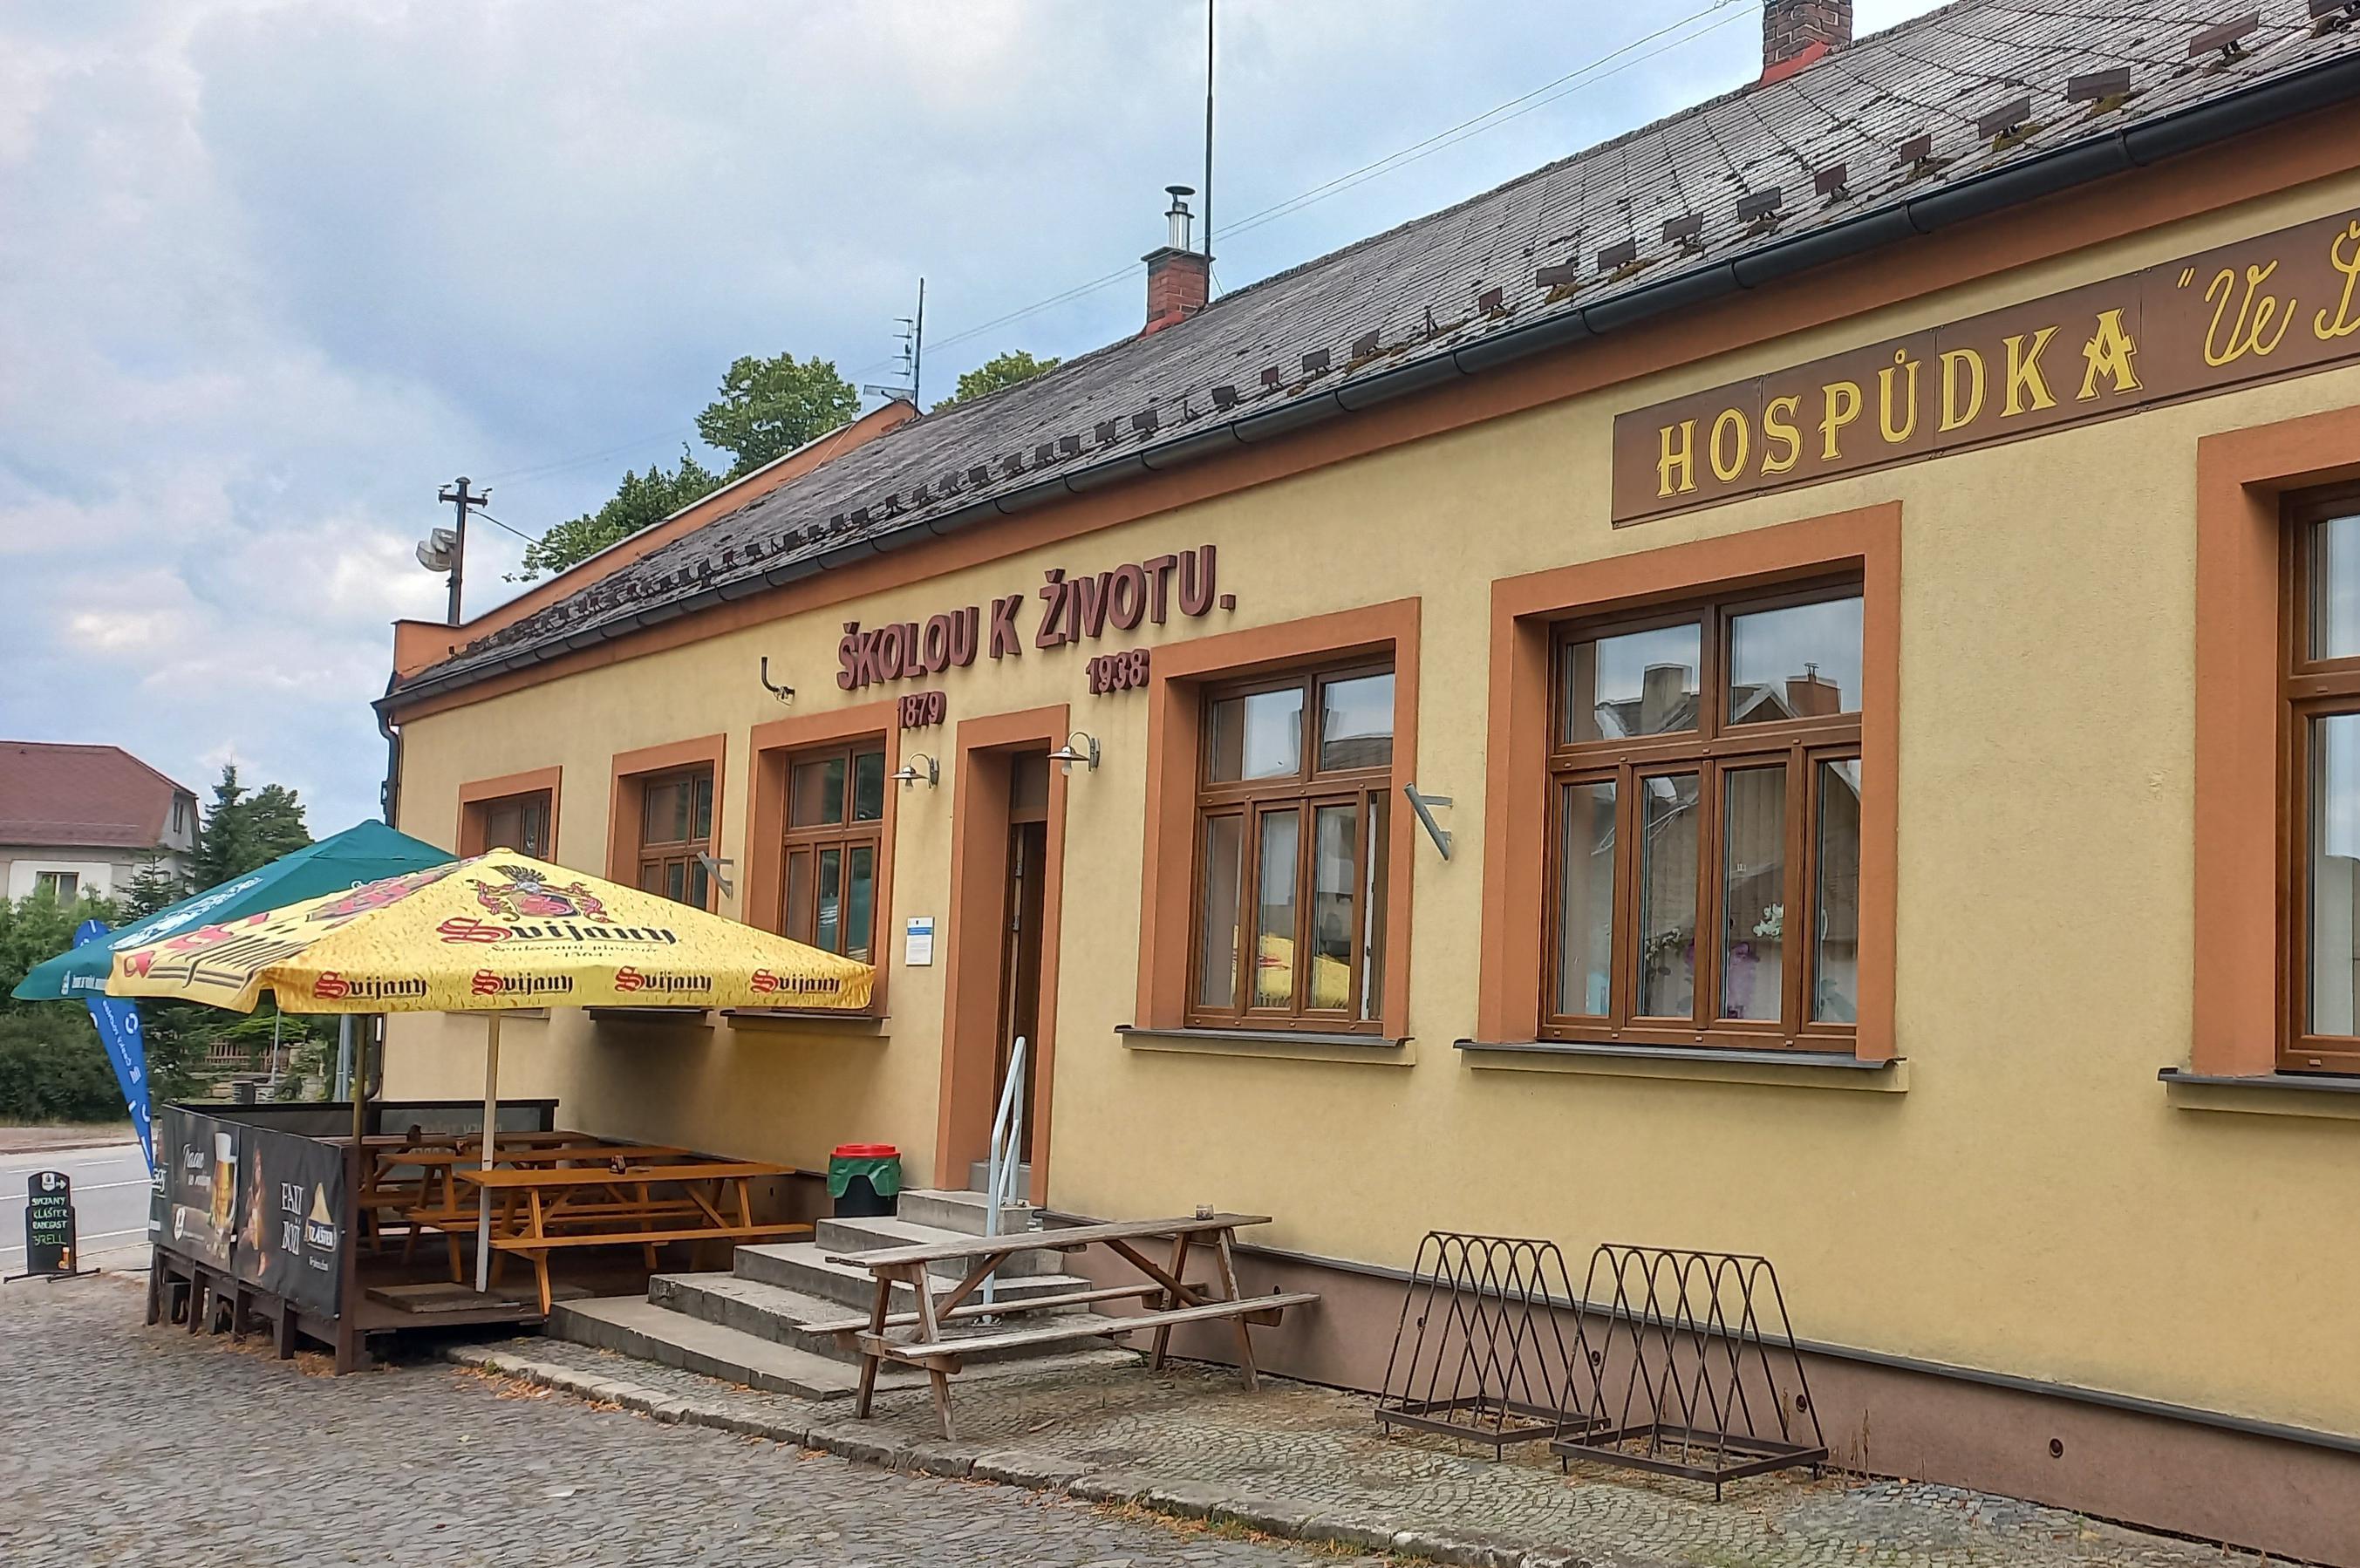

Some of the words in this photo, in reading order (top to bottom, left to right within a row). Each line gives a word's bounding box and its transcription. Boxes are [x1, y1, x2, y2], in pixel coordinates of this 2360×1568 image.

[1656, 306, 2145, 499] HOSPŮDKA
[836, 621, 979, 691] ŠKOLOU
[989, 595, 1025, 659] K
[1035, 545, 1237, 650] ŽIVOTU.
[1086, 648, 1150, 696] 1938
[897, 691, 947, 729] 1879
[436, 917, 678, 945] Svijany
[314, 971, 426, 1000] Svijany
[471, 969, 573, 996] Svijany
[615, 965, 713, 993] Svijany
[751, 968, 840, 994] Svijany
